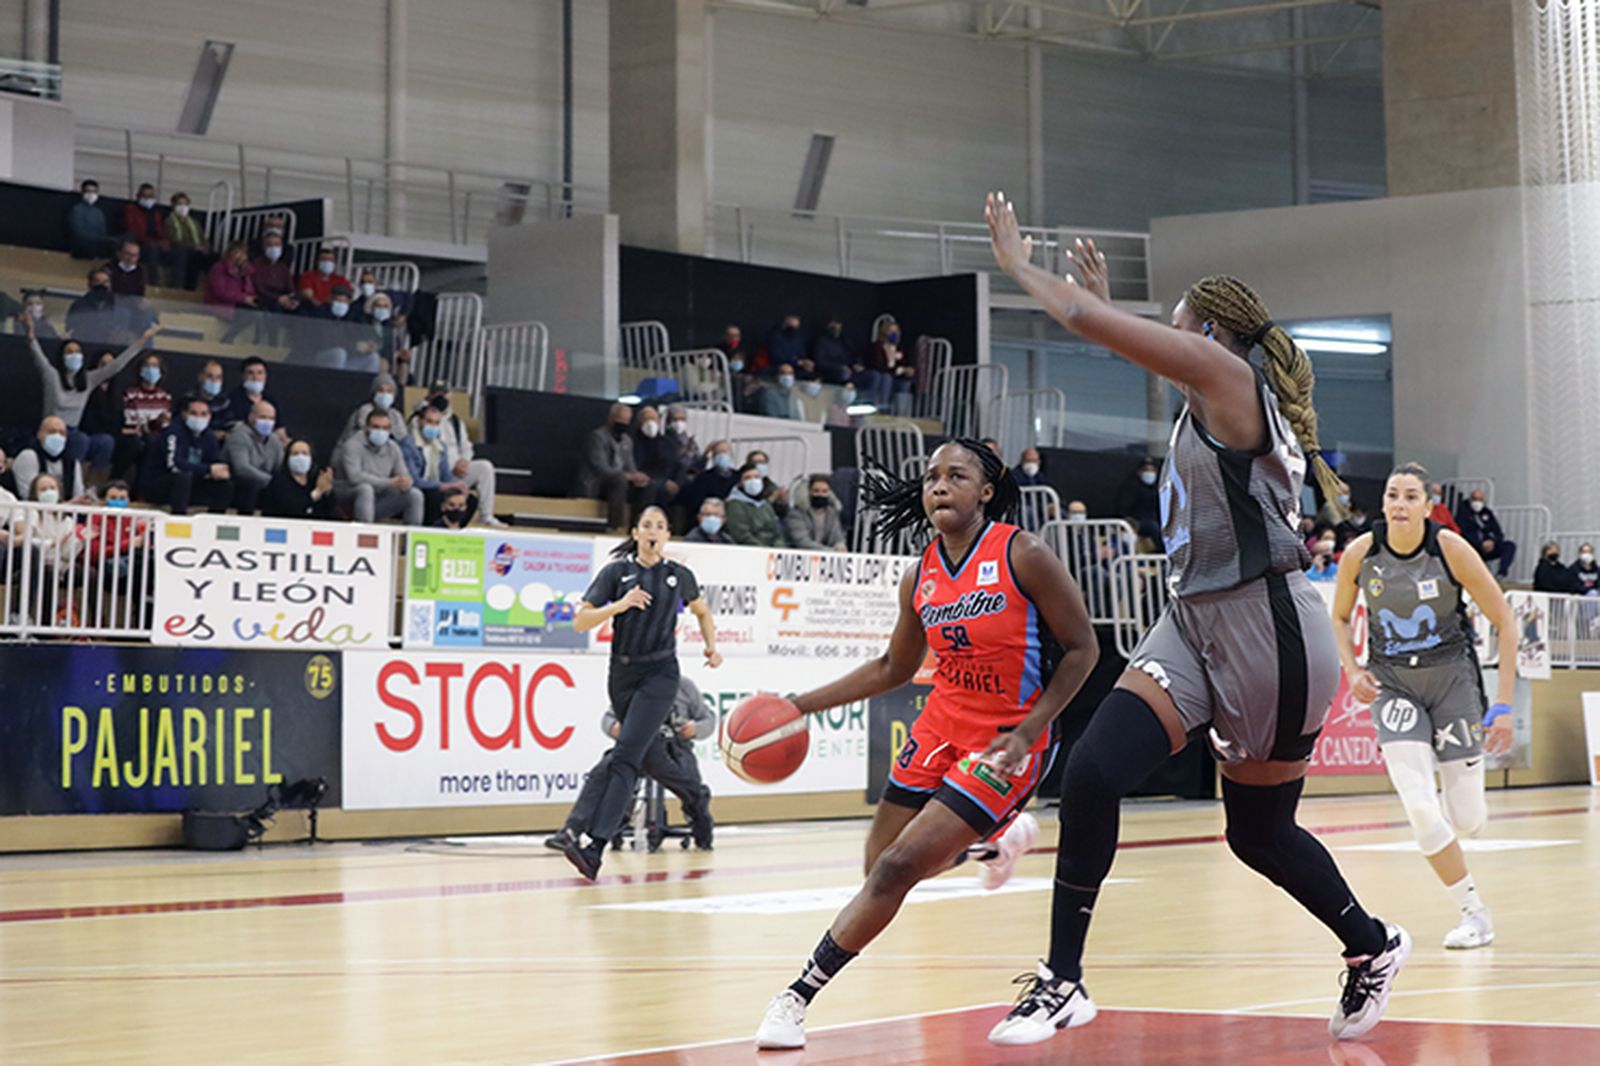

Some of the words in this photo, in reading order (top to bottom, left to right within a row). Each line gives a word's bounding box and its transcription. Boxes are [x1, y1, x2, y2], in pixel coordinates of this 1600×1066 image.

[164, 547, 376, 576] CASTILLA
[767, 552, 852, 585] COMBUTRANS
[185, 580, 213, 600] Y
[232, 578, 355, 605] LEÓN
[164, 613, 215, 640] es
[233, 606, 372, 645] vida
[815, 645, 840, 658] 606
[107, 674, 245, 693] EMBUTIDOS
[308, 665, 335, 689] 75
[1386, 697, 1415, 732] hp
[62, 706, 284, 788] PAJARIEL
[440, 775, 492, 793] more
[496, 769, 540, 792] than
[545, 772, 578, 798] you
